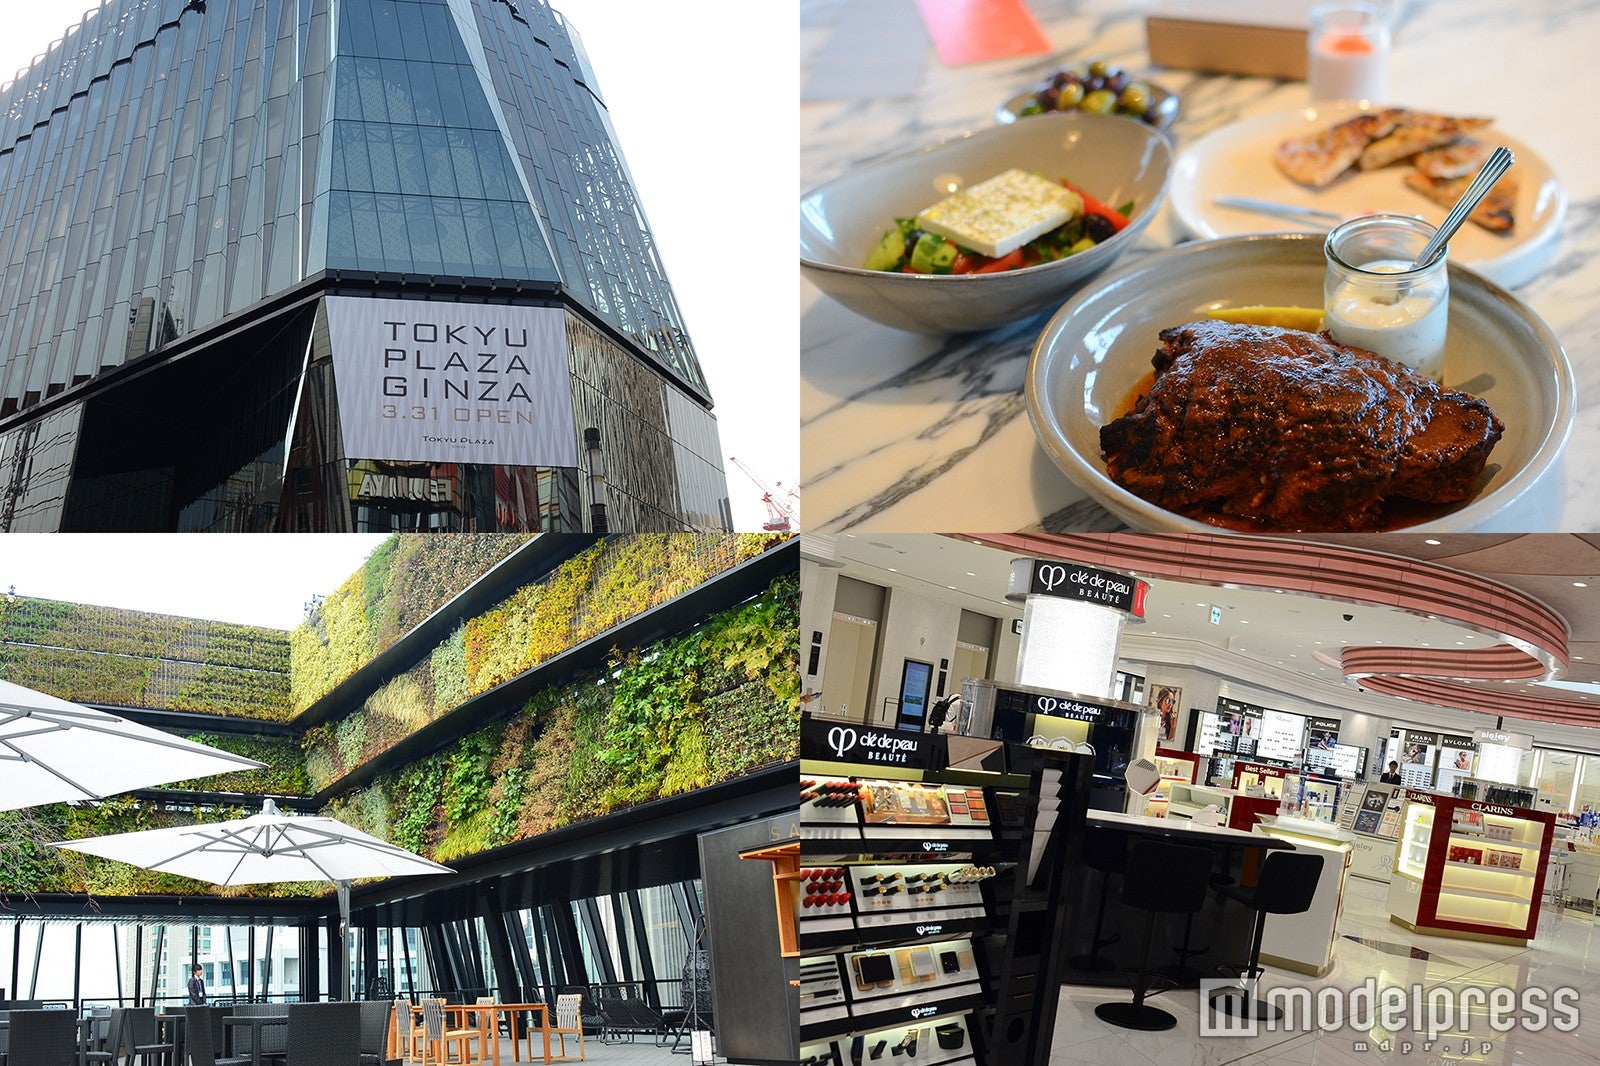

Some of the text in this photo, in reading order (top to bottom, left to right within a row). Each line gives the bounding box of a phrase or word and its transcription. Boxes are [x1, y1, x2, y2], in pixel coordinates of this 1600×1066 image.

[383, 321, 528, 348] TOKYU
[384, 348, 531, 375] PLAZA
[382, 376, 533, 403] GINZA
[382, 404, 533, 425] 3.31 OPEN
[1069, 570, 1130, 595] clé de peau
[1079, 588, 1120, 604] BEAUTÉ
[1071, 703, 1083, 713] de
[1082, 706, 1101, 716] peau
[860, 731, 918, 754] clé de peau
[1410, 734, 1432, 742] PRADA
[868, 751, 907, 763] BEAUTÉ
[1245, 764, 1279, 776] Best Sellers
[1410, 792, 1432, 803] CLARINS
[1471, 802, 1514, 815] CLARINS
